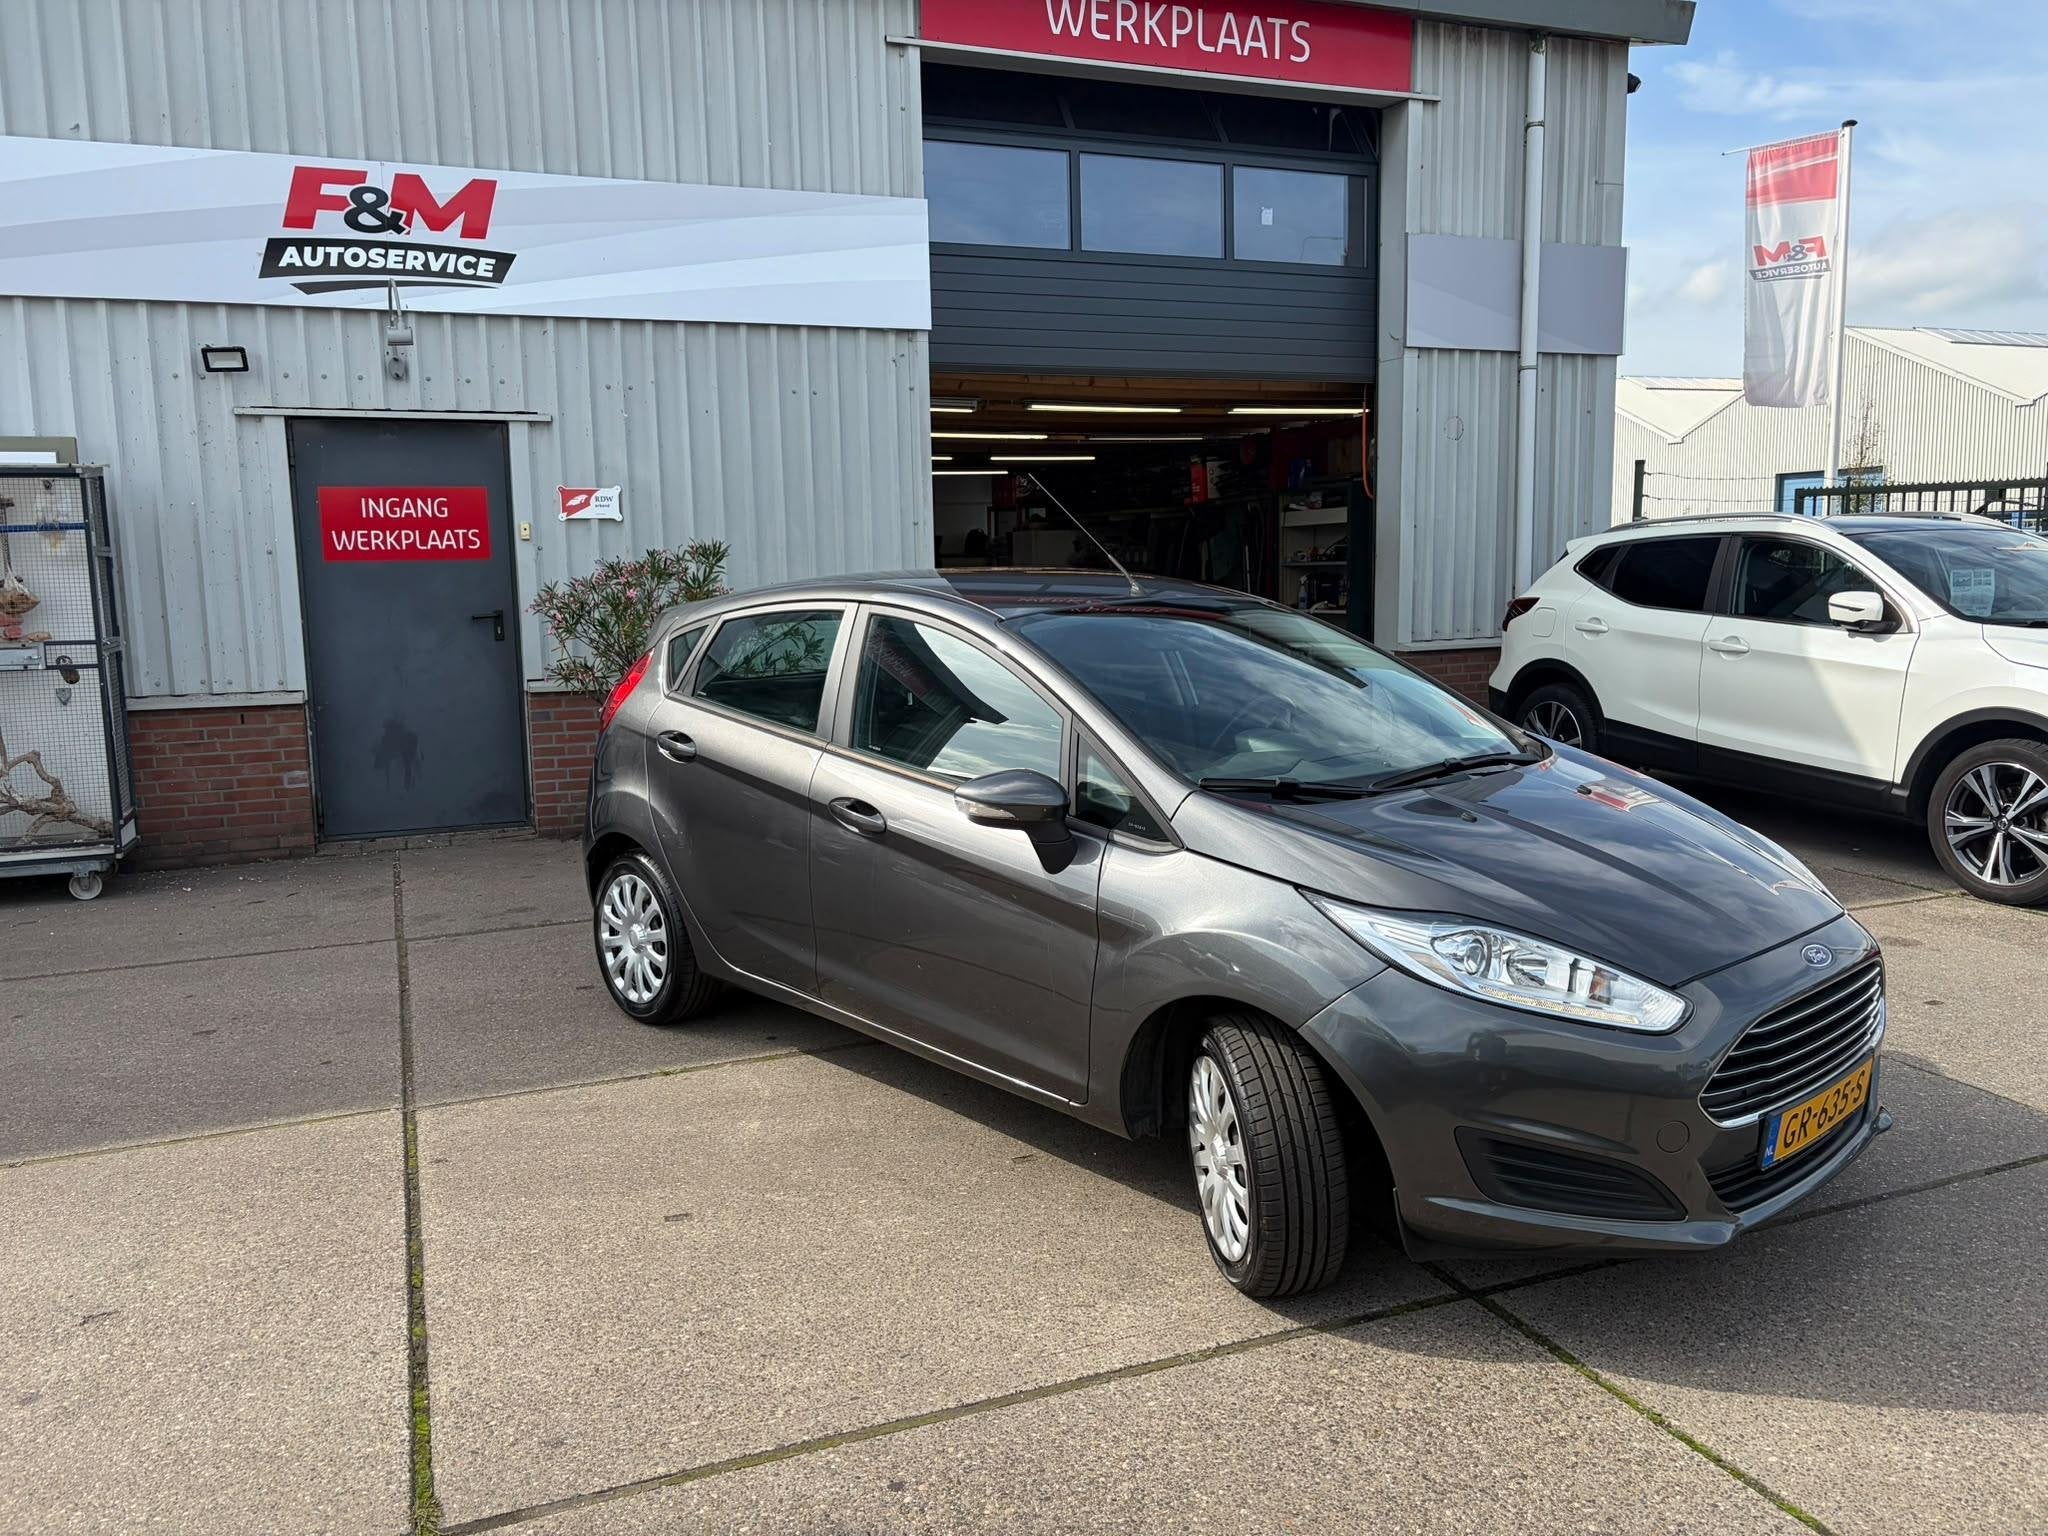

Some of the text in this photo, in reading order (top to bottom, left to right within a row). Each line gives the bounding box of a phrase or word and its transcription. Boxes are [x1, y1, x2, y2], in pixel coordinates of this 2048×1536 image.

[1045, 0, 1311, 63] WERKPLAATS
[282, 165, 498, 240] F&M
[278, 246, 496, 277] AUTOSERVICE
[361, 498, 448, 518] INGANG
[594, 495, 614, 503] RDW
[331, 528, 481, 551] WERKPLAATS
[1783, 1069, 1866, 1149] GR-635-S
